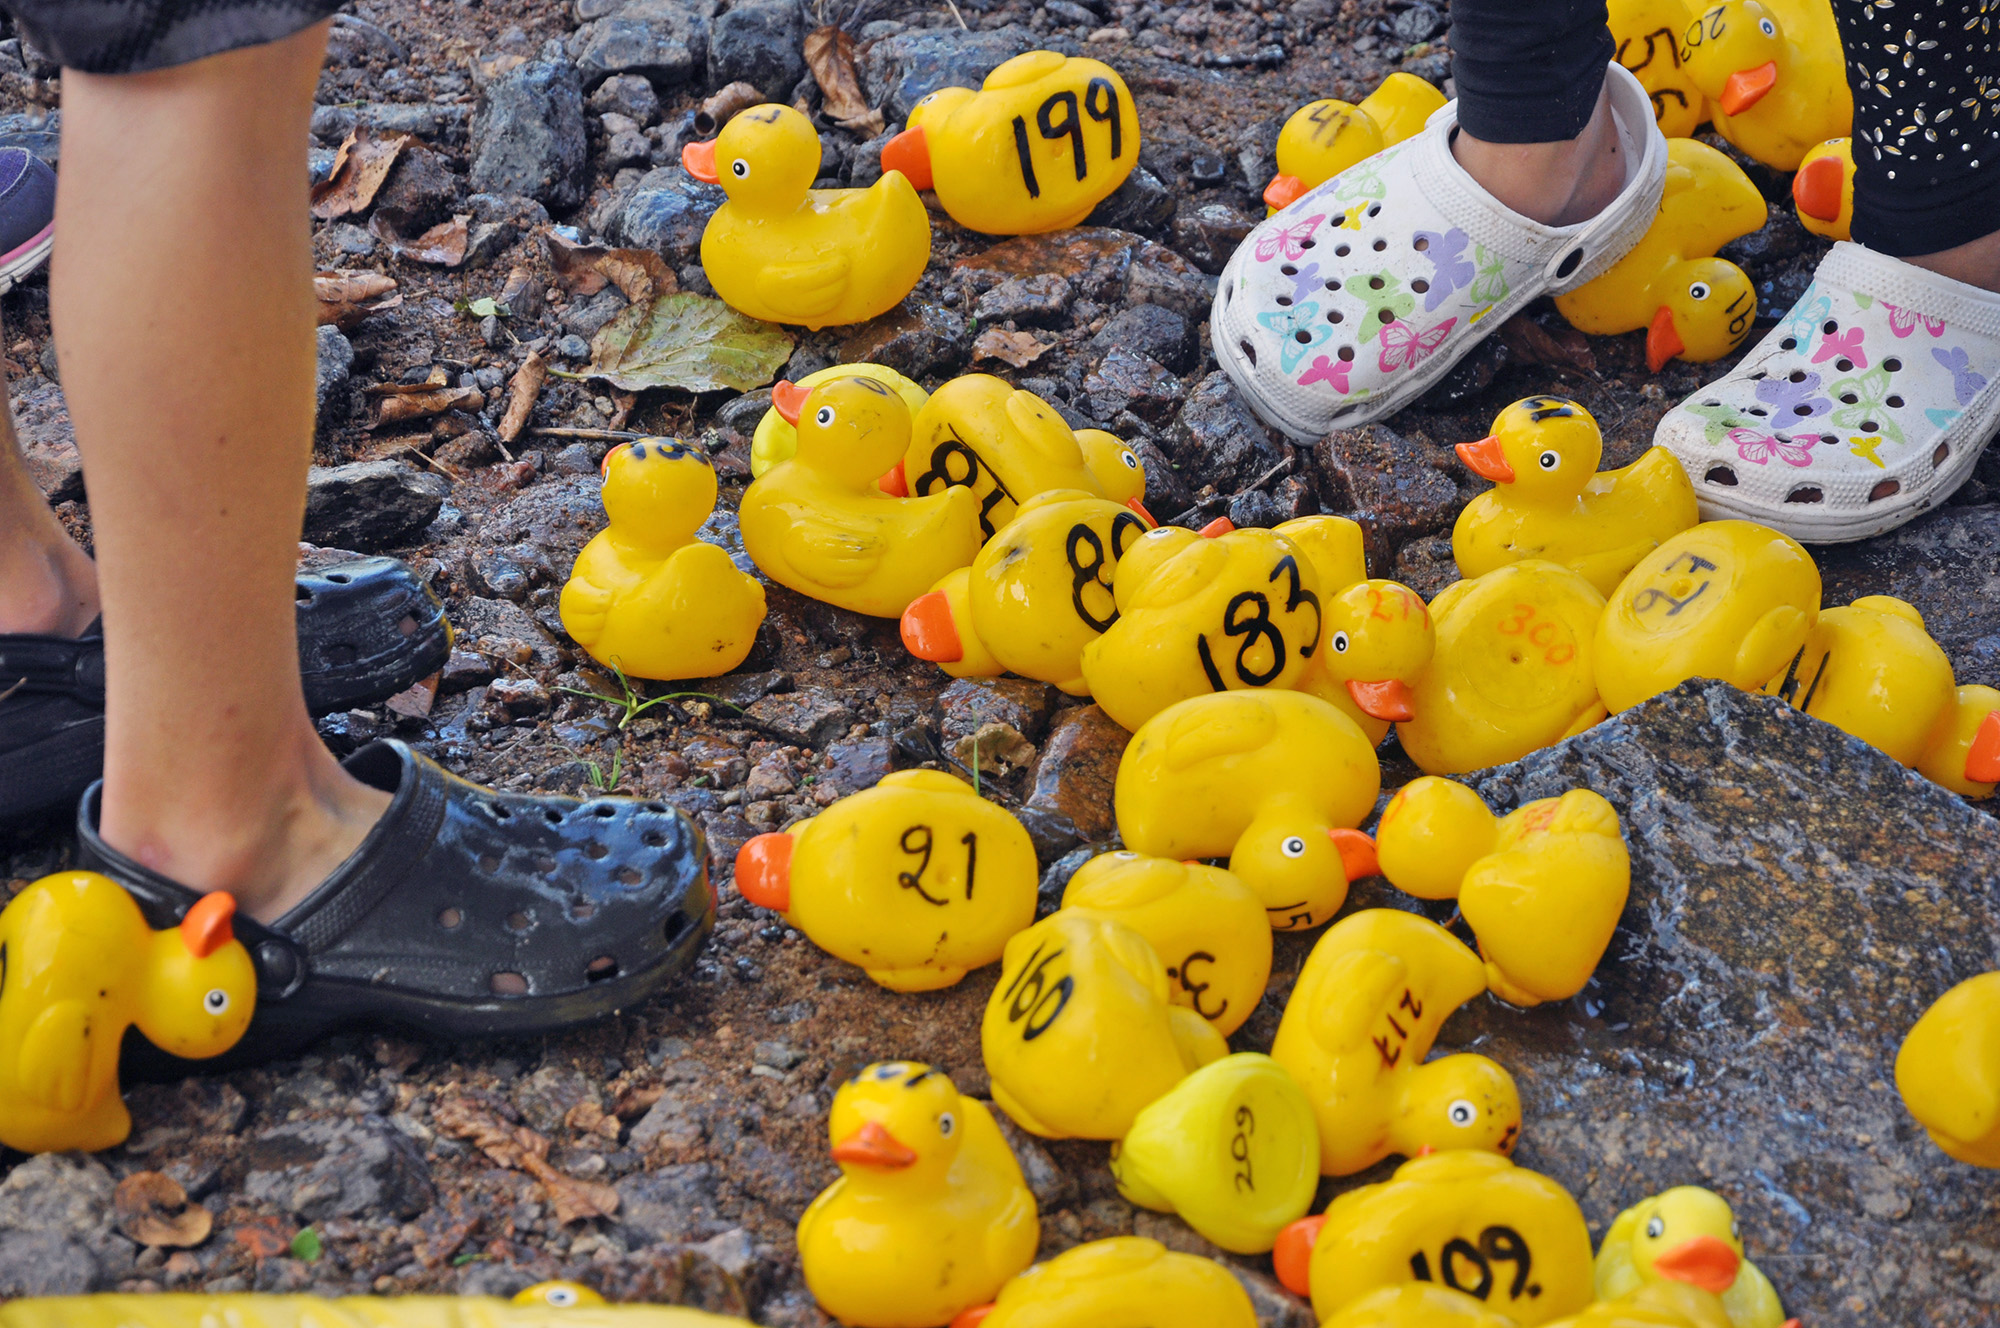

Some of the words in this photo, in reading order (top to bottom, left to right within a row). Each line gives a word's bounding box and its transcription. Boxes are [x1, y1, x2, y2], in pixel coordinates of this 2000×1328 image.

[1012, 77, 1122, 200] 199
[1197, 555, 1322, 692] 183
[1497, 604, 1575, 665] 300
[898, 823, 977, 906] 21
[1002, 942, 1075, 1041] 160
[1231, 1105, 1255, 1192] 209
